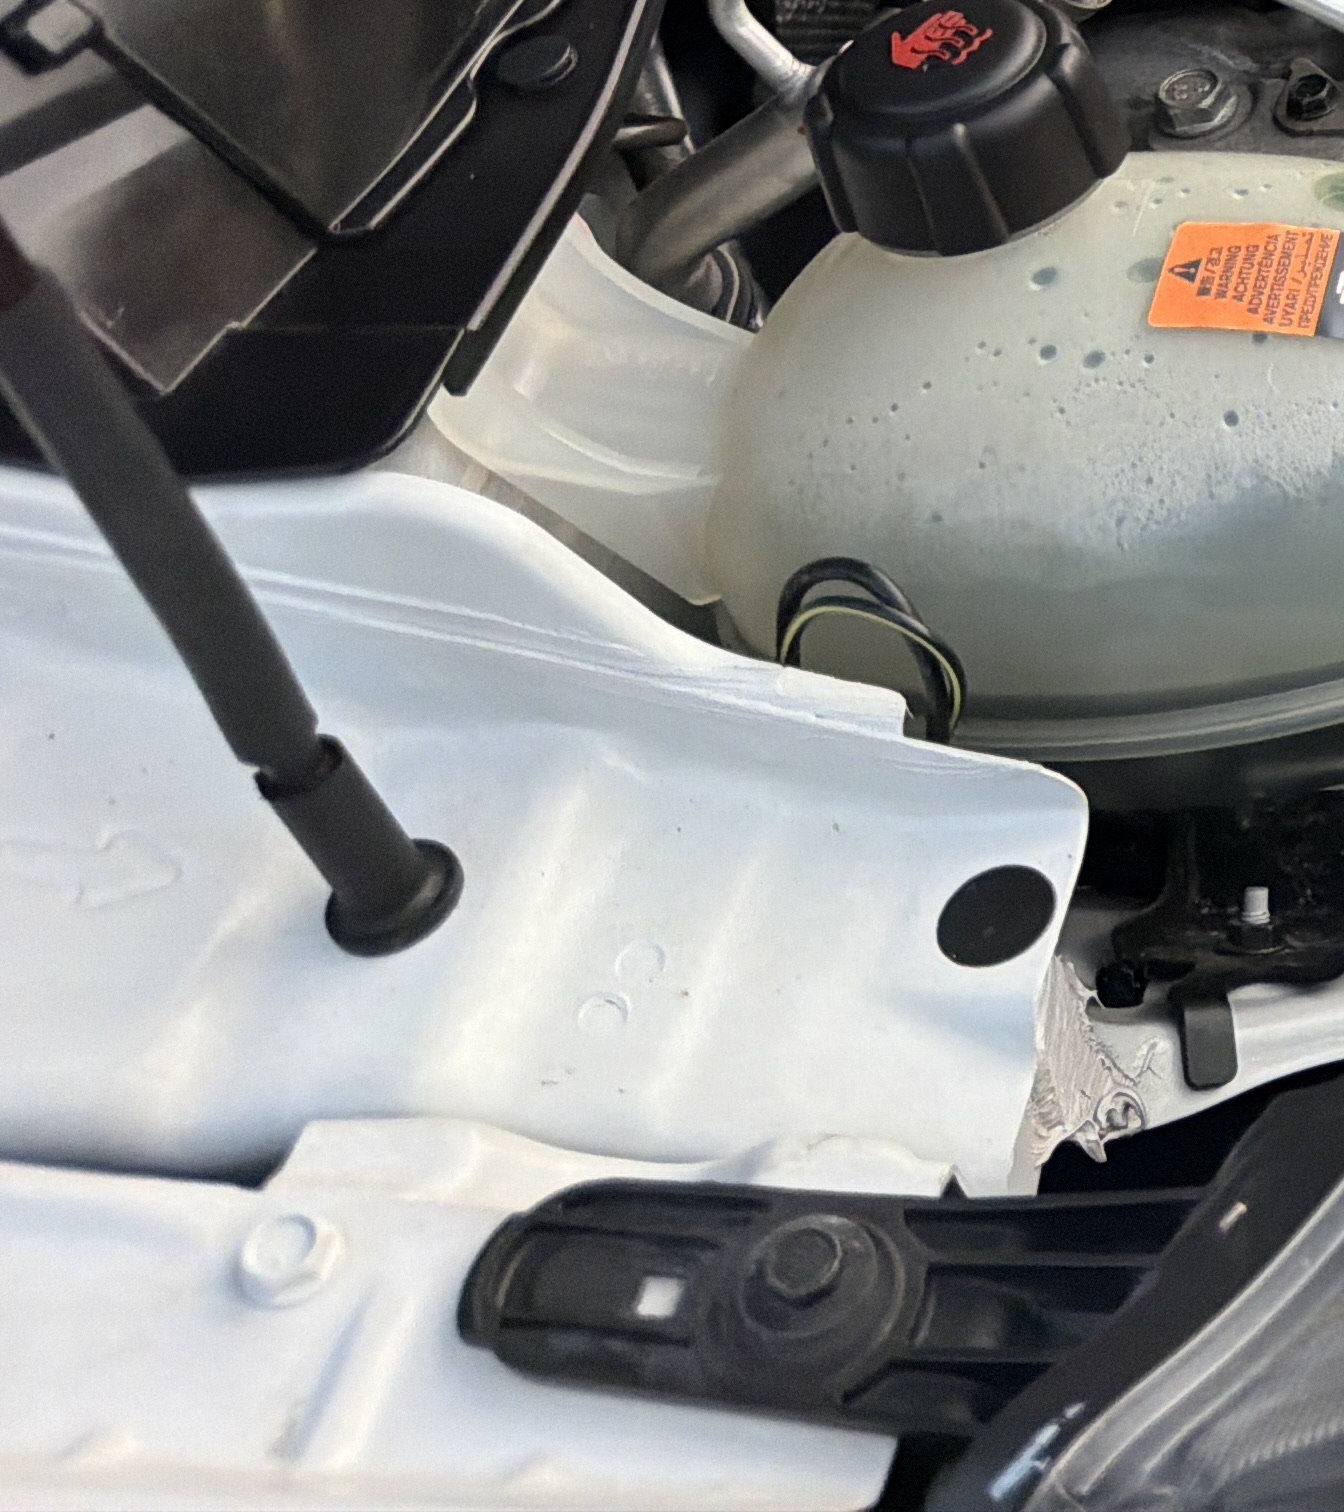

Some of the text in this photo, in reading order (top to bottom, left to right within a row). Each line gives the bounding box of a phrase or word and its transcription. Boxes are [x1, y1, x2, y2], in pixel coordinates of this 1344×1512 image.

[1213, 244, 1242, 300] WARNING
[1231, 243, 1260, 303] ACHTUNG
[1263, 230, 1301, 326] AVERTISSEMENT
